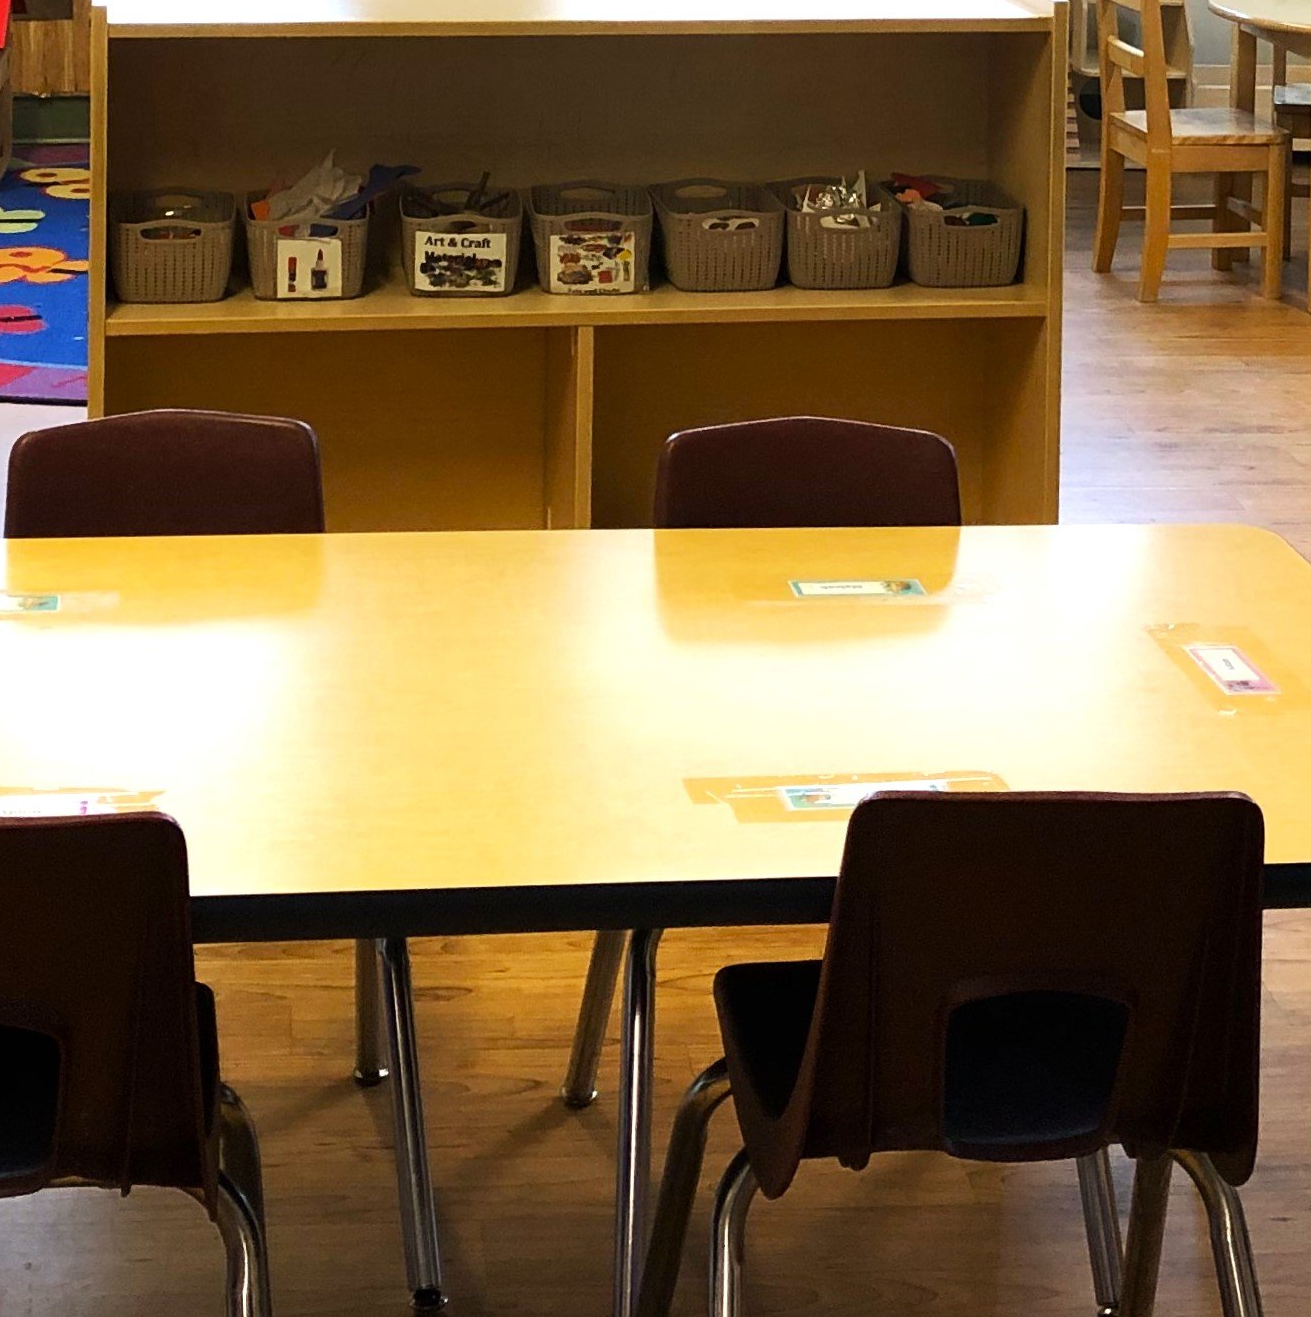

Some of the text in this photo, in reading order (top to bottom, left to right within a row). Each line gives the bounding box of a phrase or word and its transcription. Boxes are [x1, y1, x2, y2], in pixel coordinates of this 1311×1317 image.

[425, 236, 492, 248] Art & Craft
